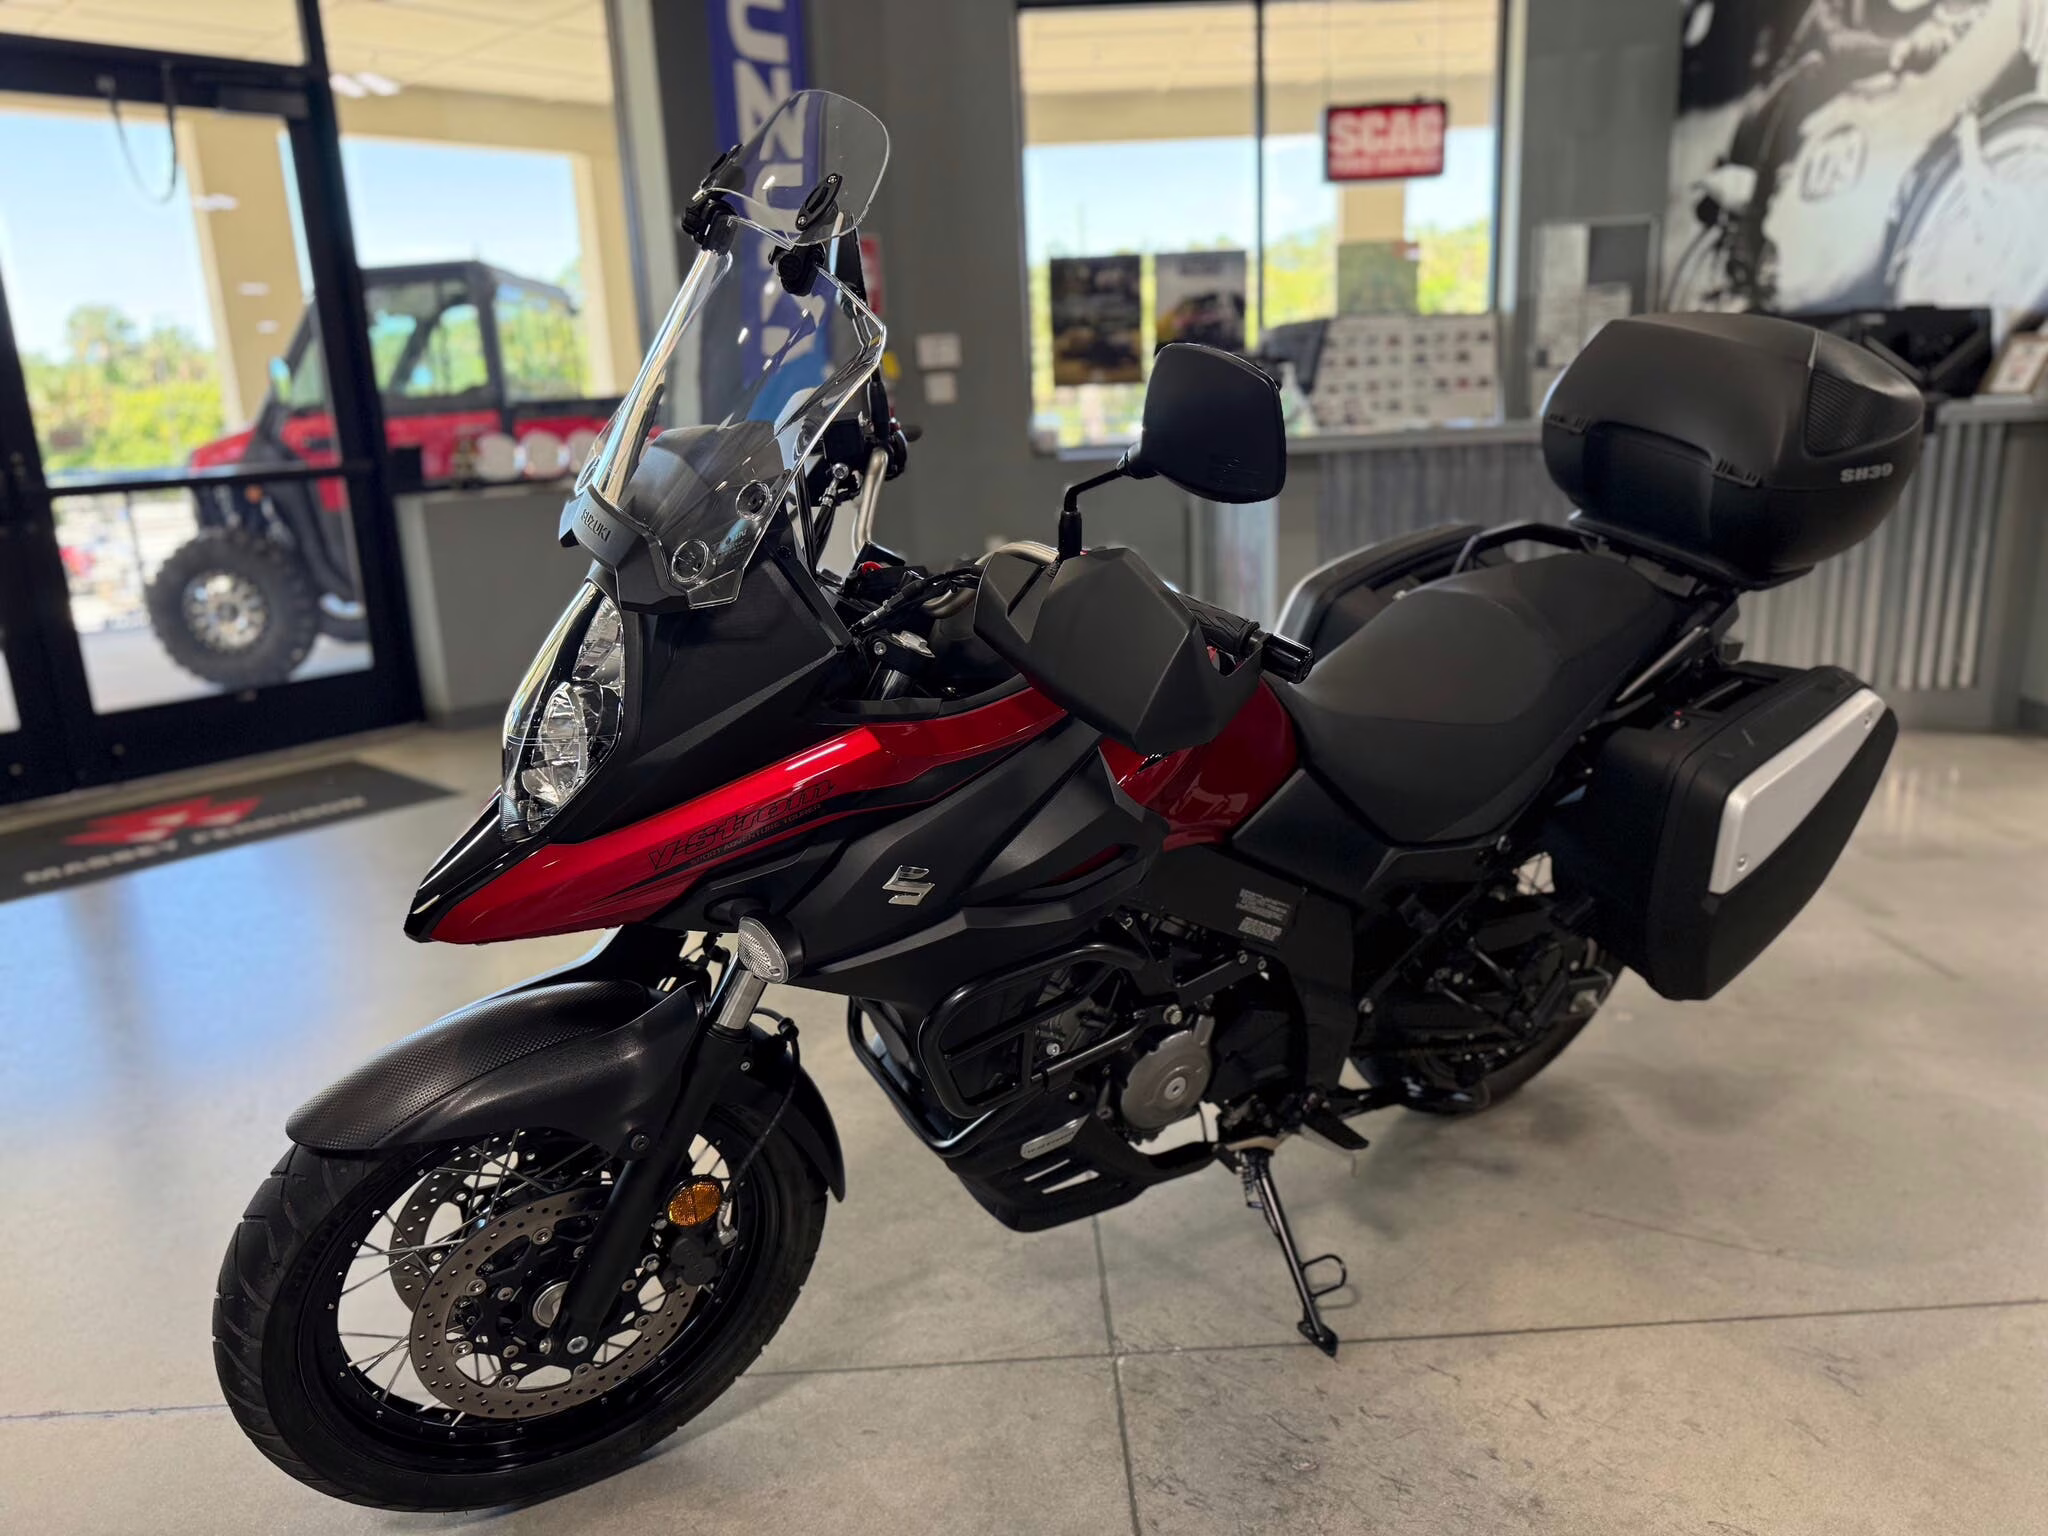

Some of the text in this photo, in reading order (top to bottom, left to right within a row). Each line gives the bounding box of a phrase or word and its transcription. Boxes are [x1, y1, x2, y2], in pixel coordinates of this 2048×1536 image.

[1330, 107, 1442, 153] SCAG
[1841, 462, 1894, 482] SH39
[581, 508, 612, 542] SUZUKI
[724, 822, 780, 851] ADVENTURE
[783, 803, 822, 825] TOURER
